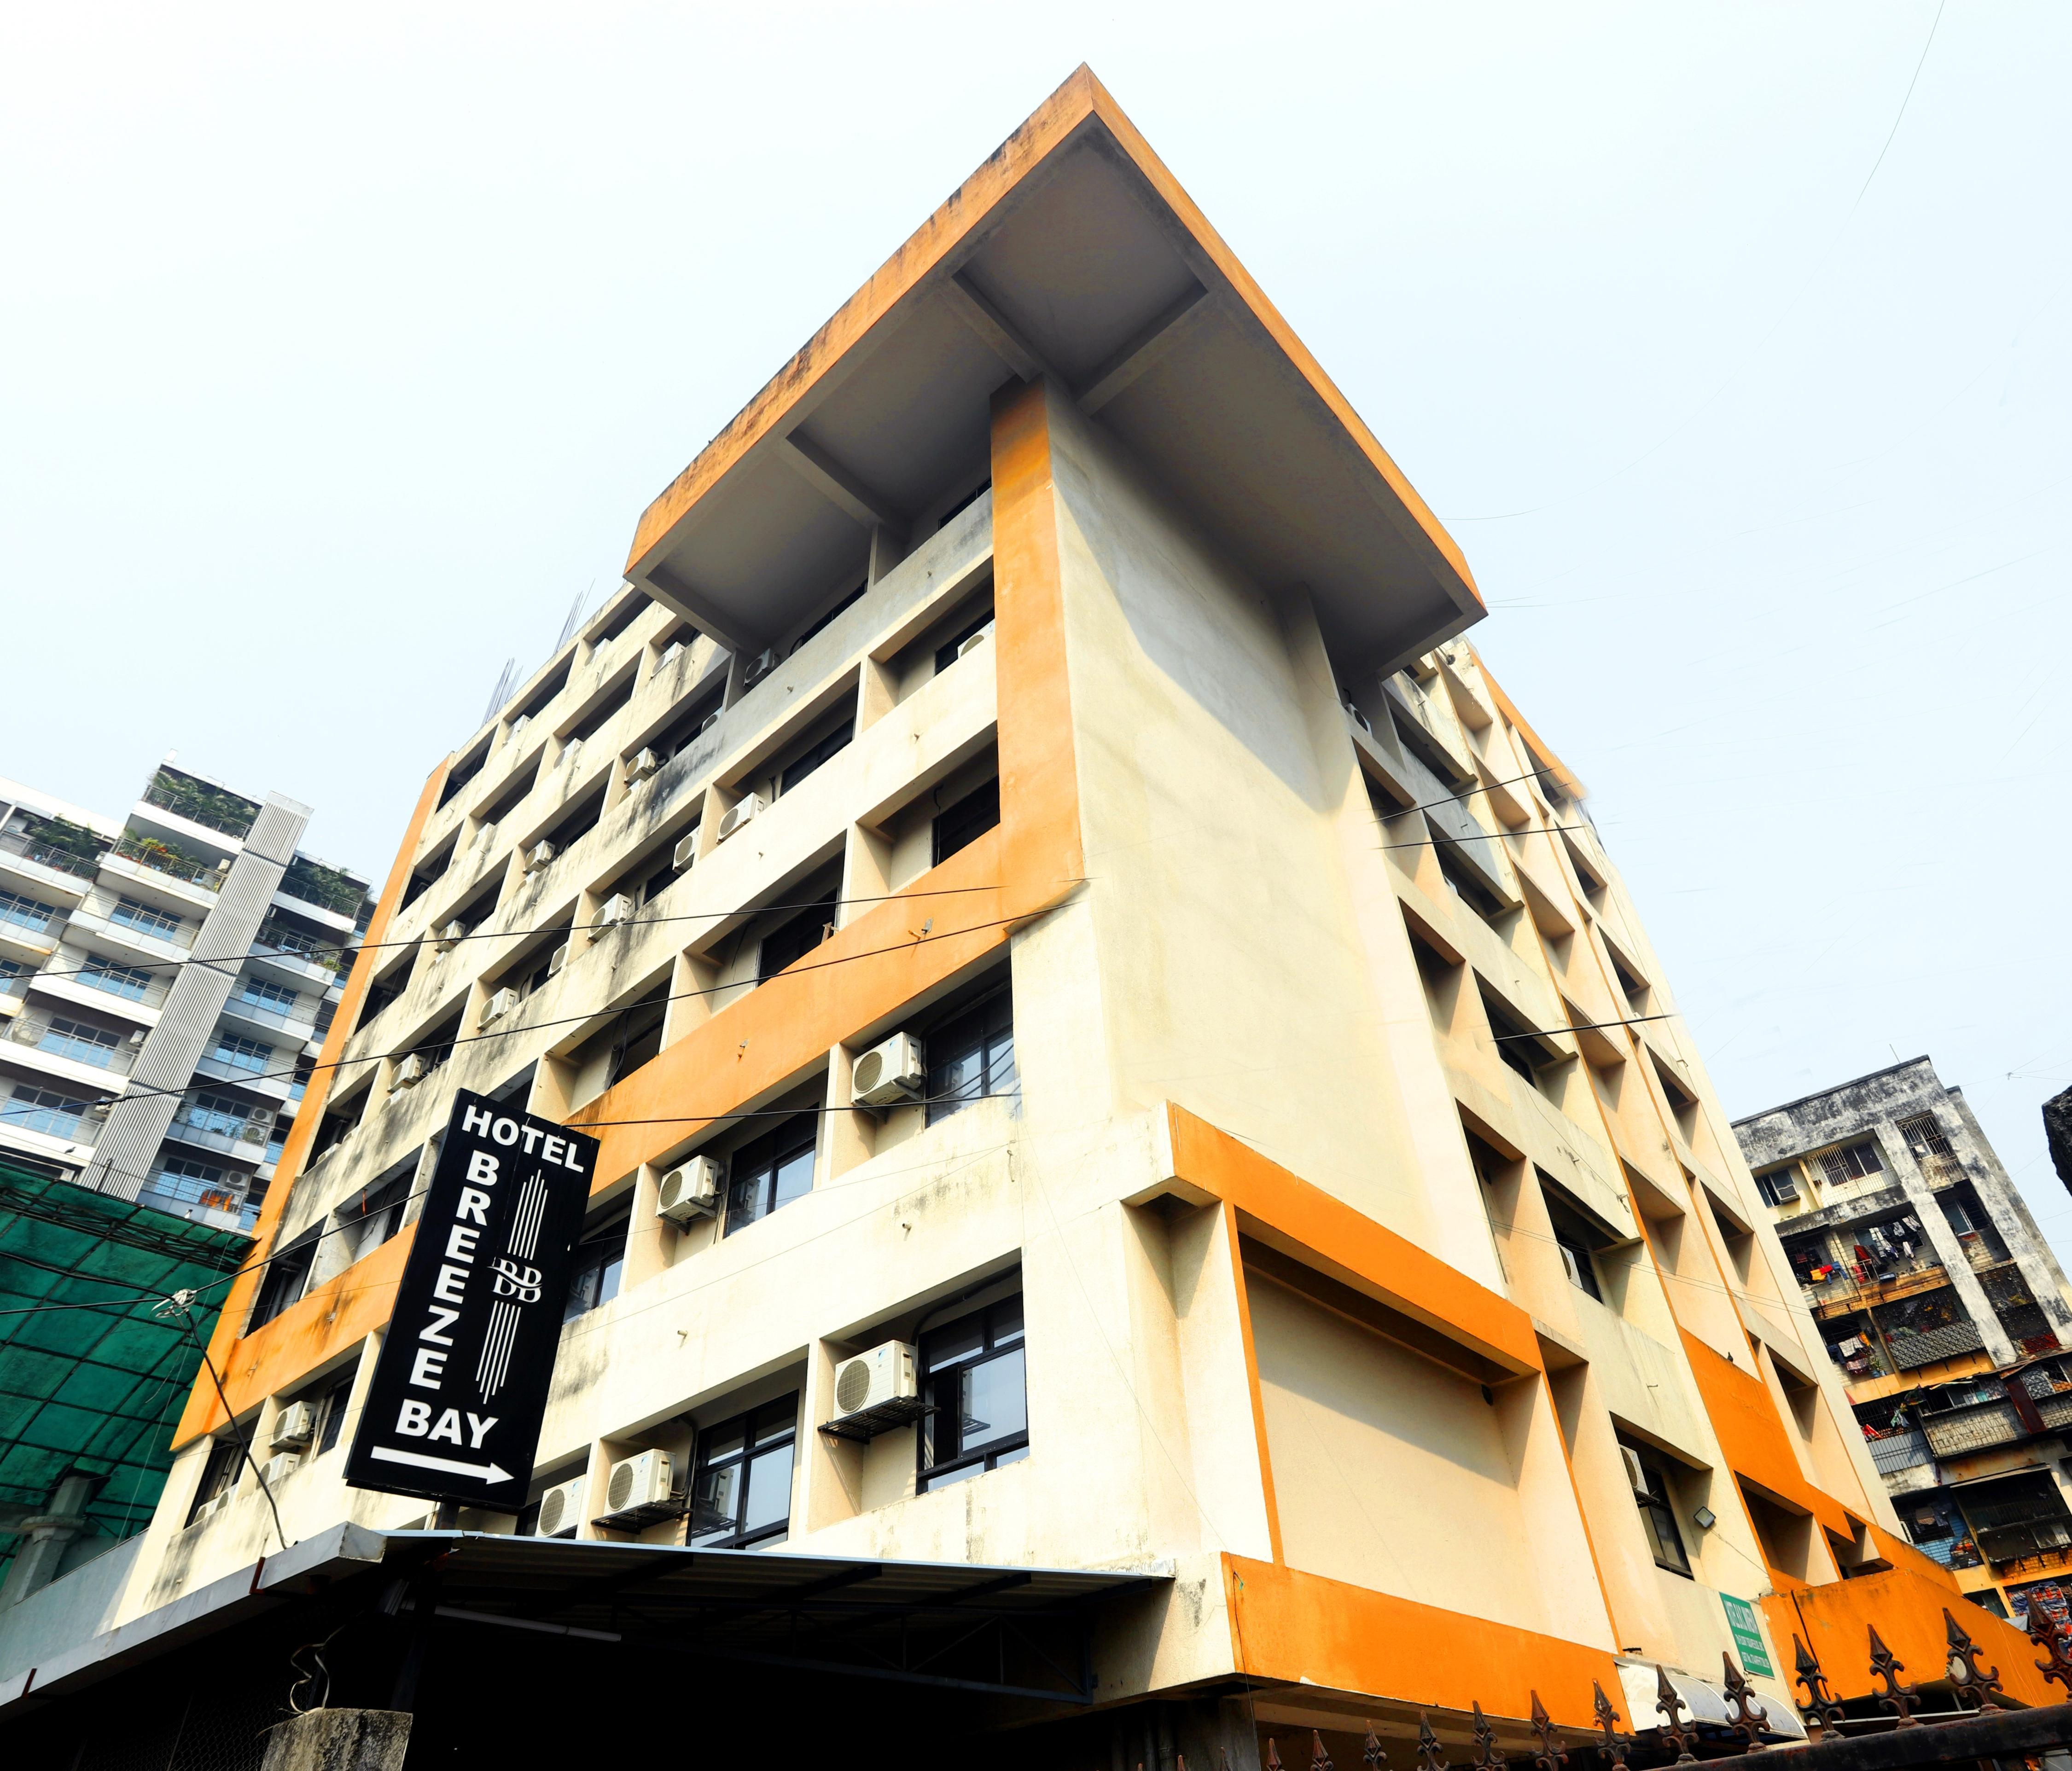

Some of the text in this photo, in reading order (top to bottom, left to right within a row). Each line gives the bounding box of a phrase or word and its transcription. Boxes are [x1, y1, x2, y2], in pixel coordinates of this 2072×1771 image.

[462, 1105, 584, 1173] HOTEL
[409, 1150, 500, 1390] BREEZE
[395, 1399, 499, 1449] BAY
